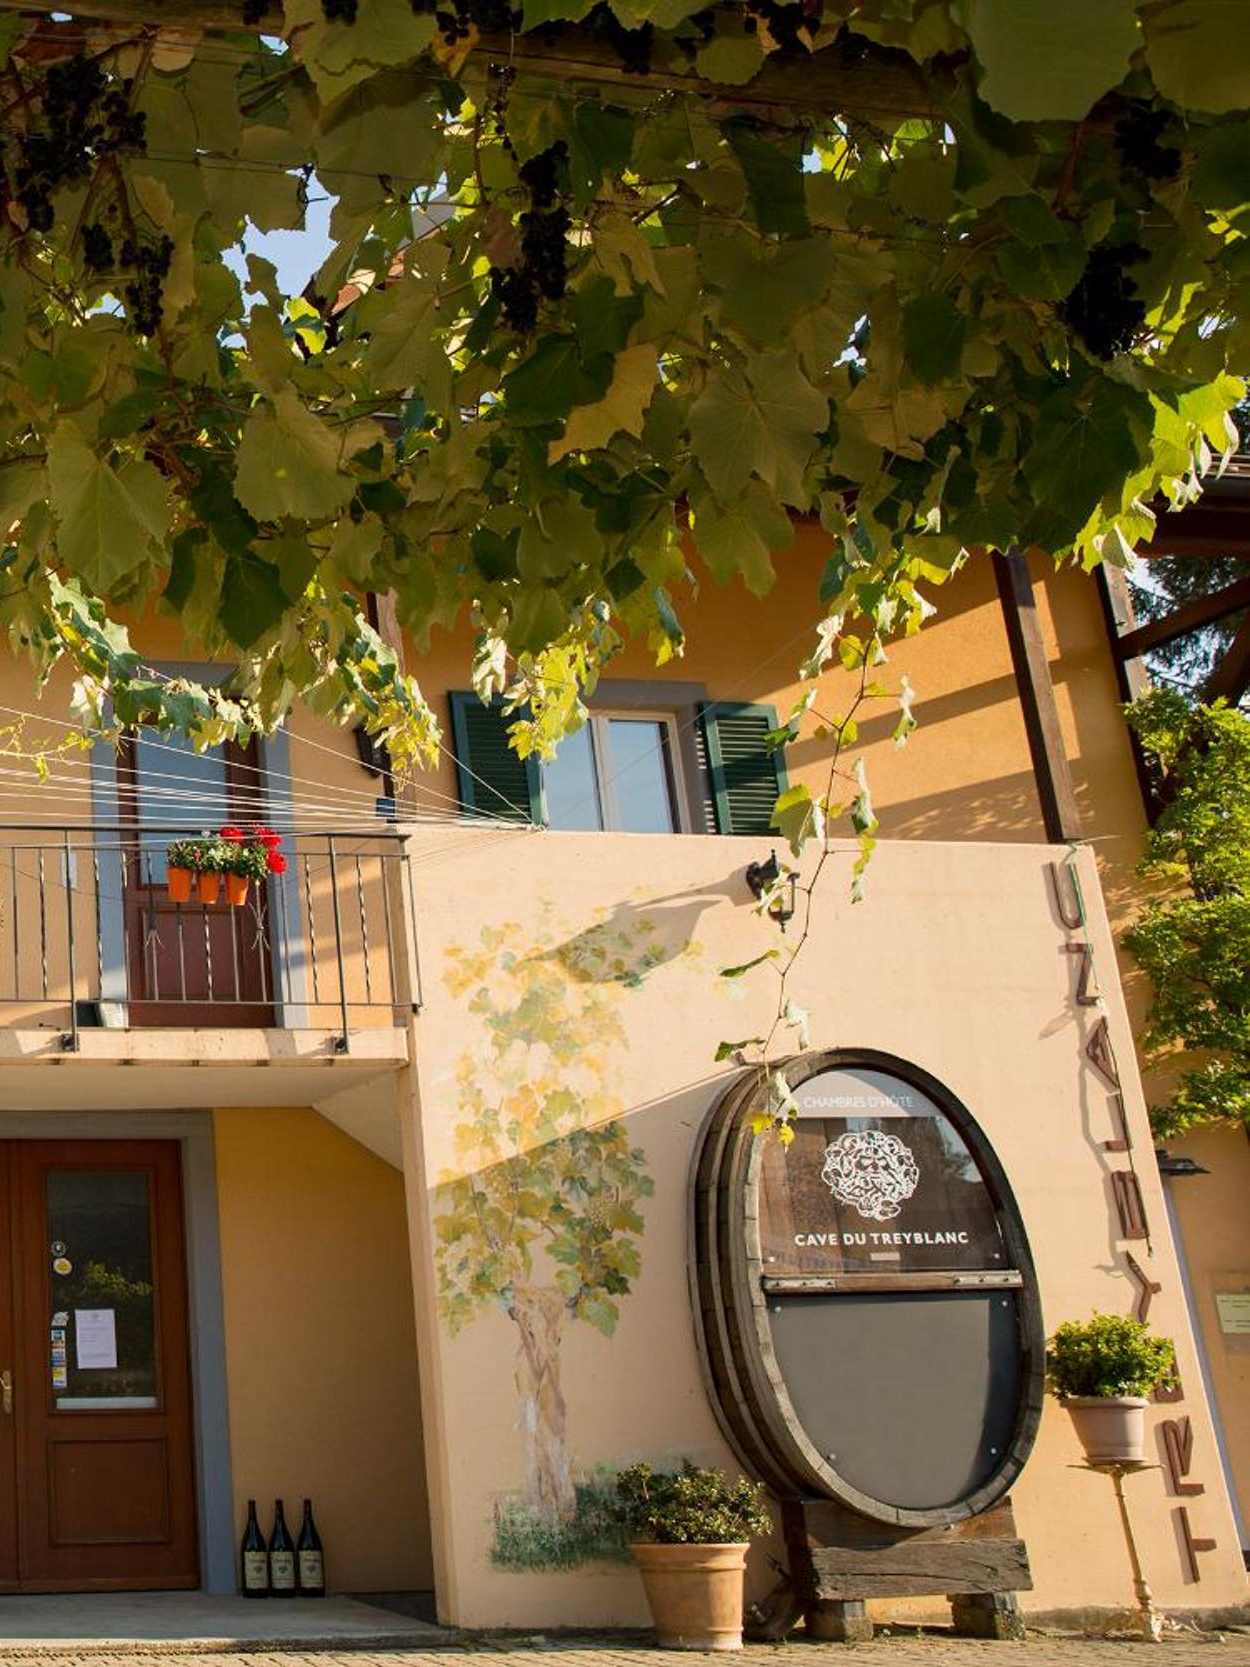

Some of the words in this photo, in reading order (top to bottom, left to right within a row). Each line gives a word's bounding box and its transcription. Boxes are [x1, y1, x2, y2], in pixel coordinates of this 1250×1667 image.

[803, 1096, 866, 1108] CHAMBRES
[794, 1233, 838, 1246] CAVE
[843, 1233, 866, 1245] DU
[870, 1231, 969, 1245] TREYBLANC
